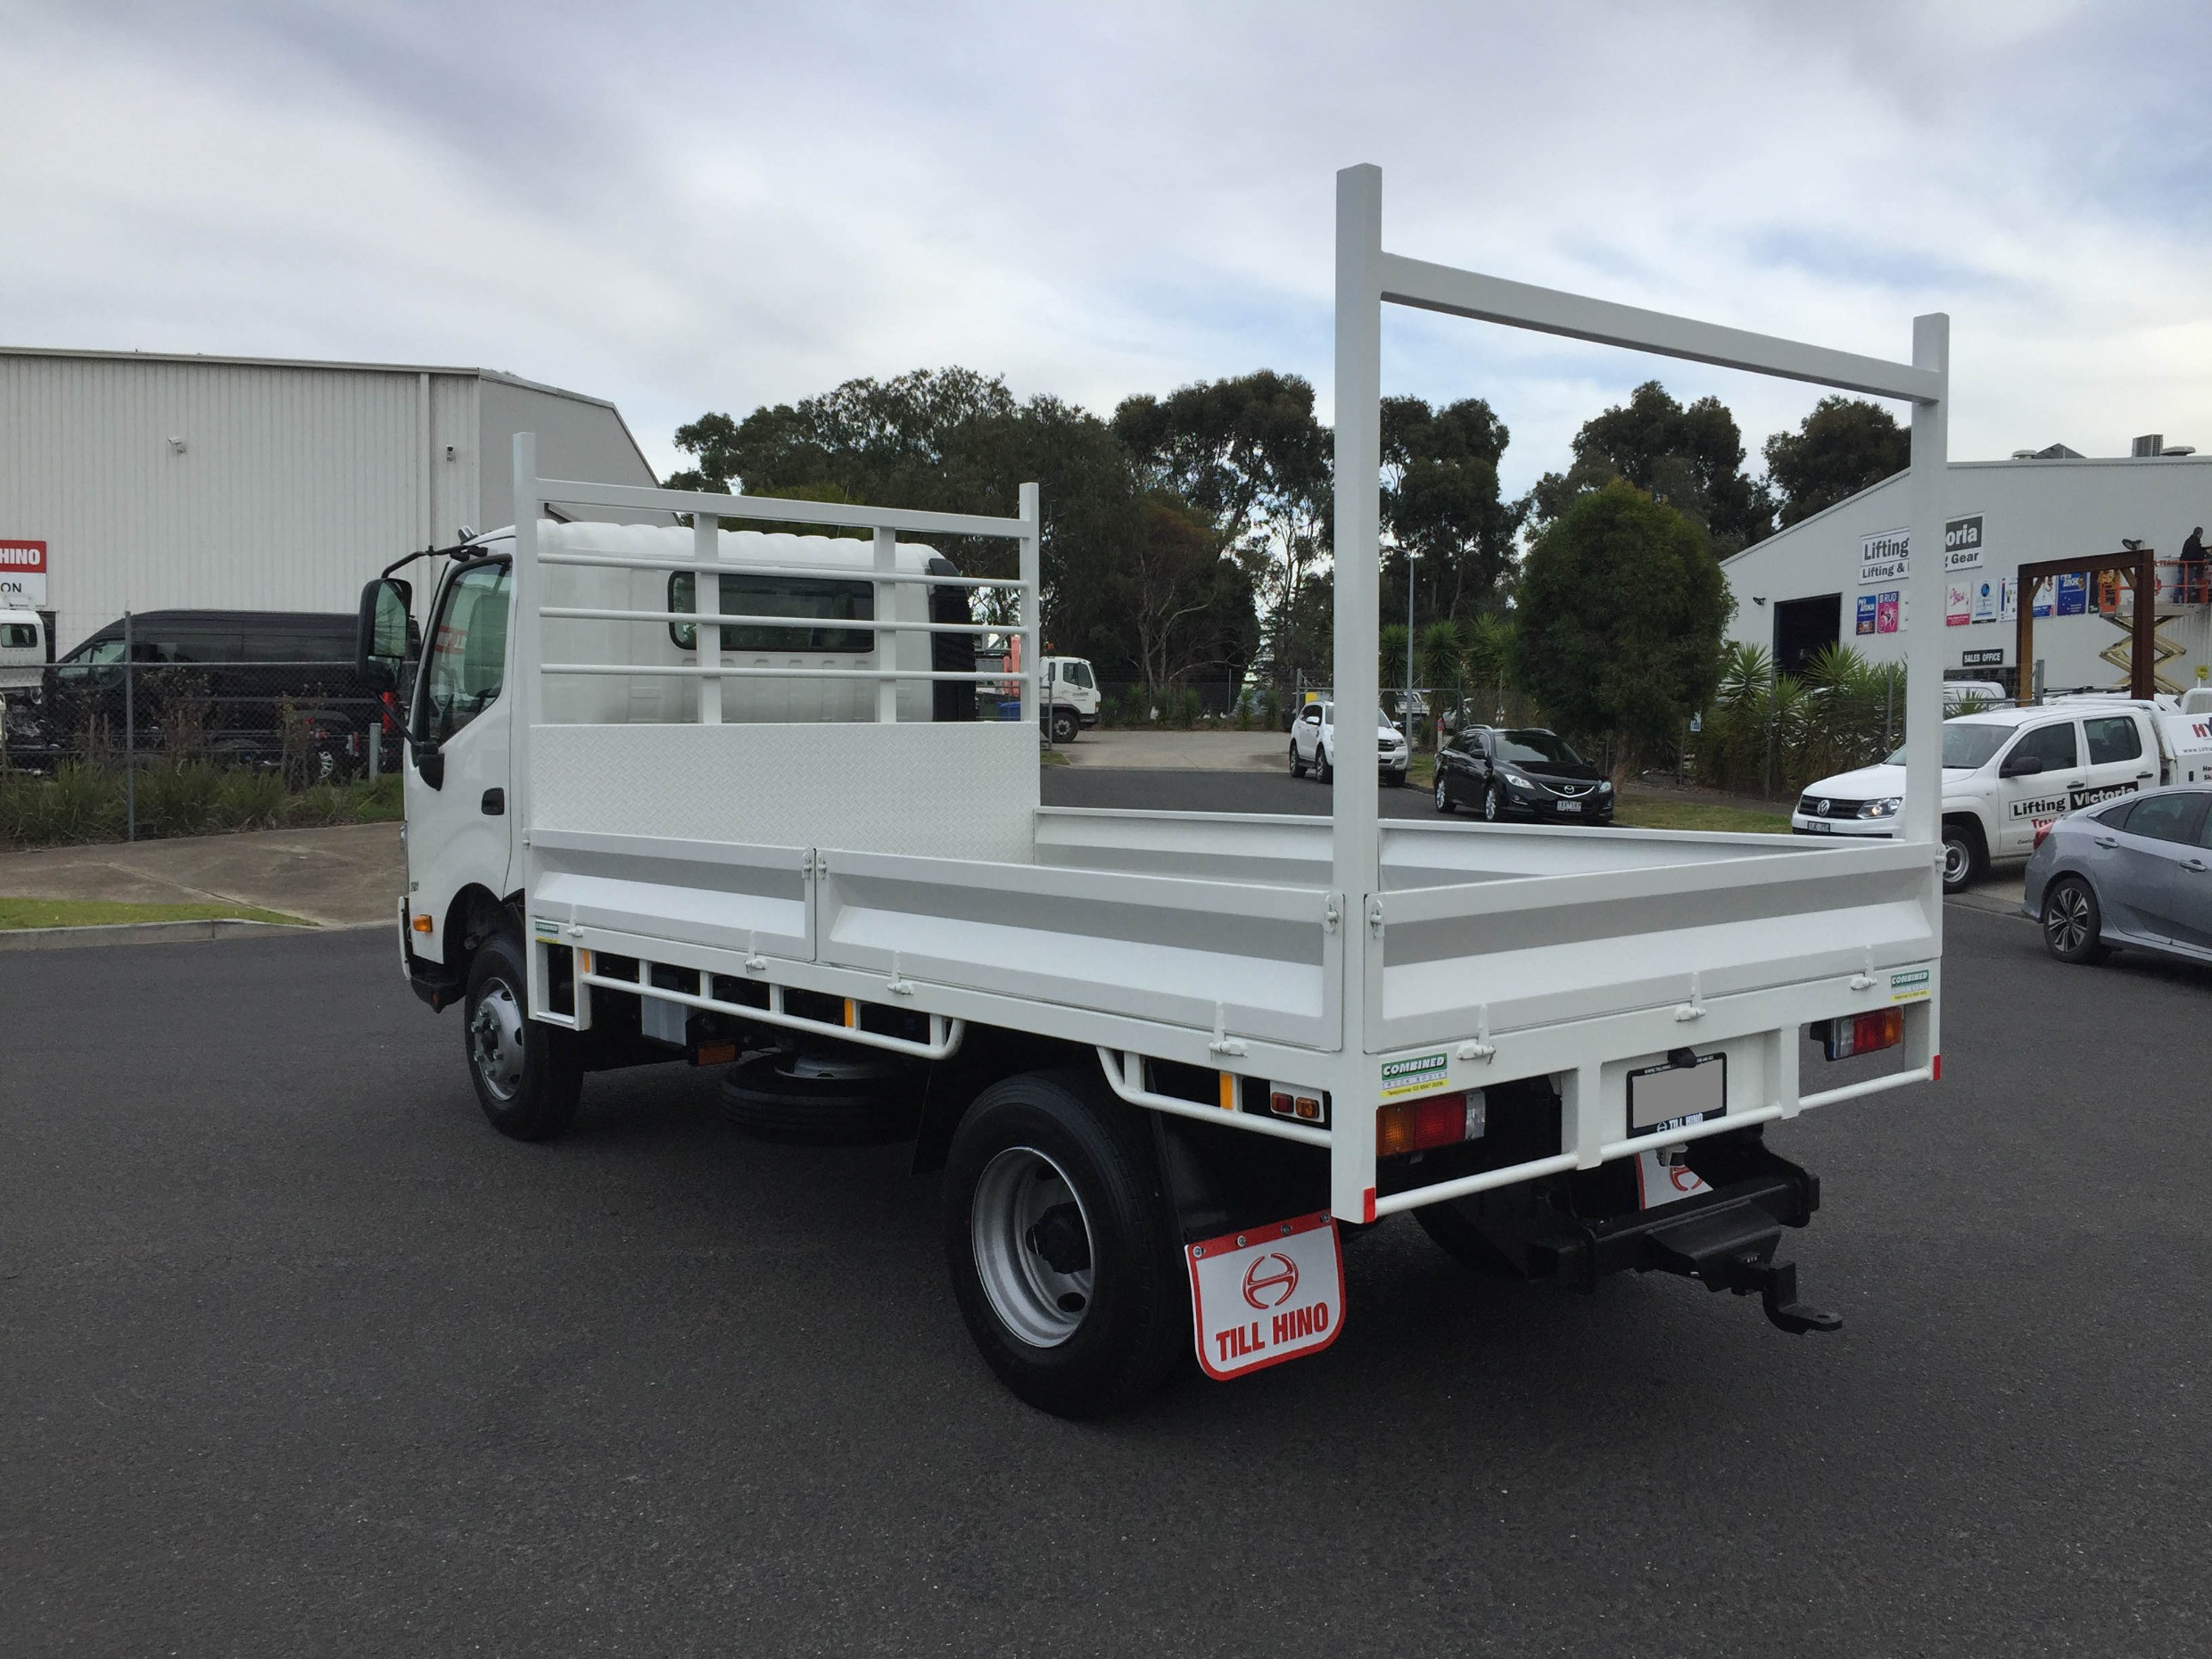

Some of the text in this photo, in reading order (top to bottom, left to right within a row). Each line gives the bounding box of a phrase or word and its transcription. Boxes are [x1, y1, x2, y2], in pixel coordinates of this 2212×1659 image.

[1946, 524, 1977, 547] oria
[0, 548, 41, 565] HINO
[1864, 538, 1910, 560] Lifting
[1951, 552, 1979, 565] Gear
[1862, 565, 1894, 579] Lifting
[1896, 562, 1905, 573] &
[1964, 652, 2002, 664] SALES OFFICE
[2013, 787, 2135, 816] Lifting Victoria
[1891, 972, 1927, 986] COMBINED
[1382, 1056, 1445, 1077] COMBINED
[1669, 1112, 1704, 1129] TILL HINO
[1215, 1301, 1329, 1362] TILL HINO
